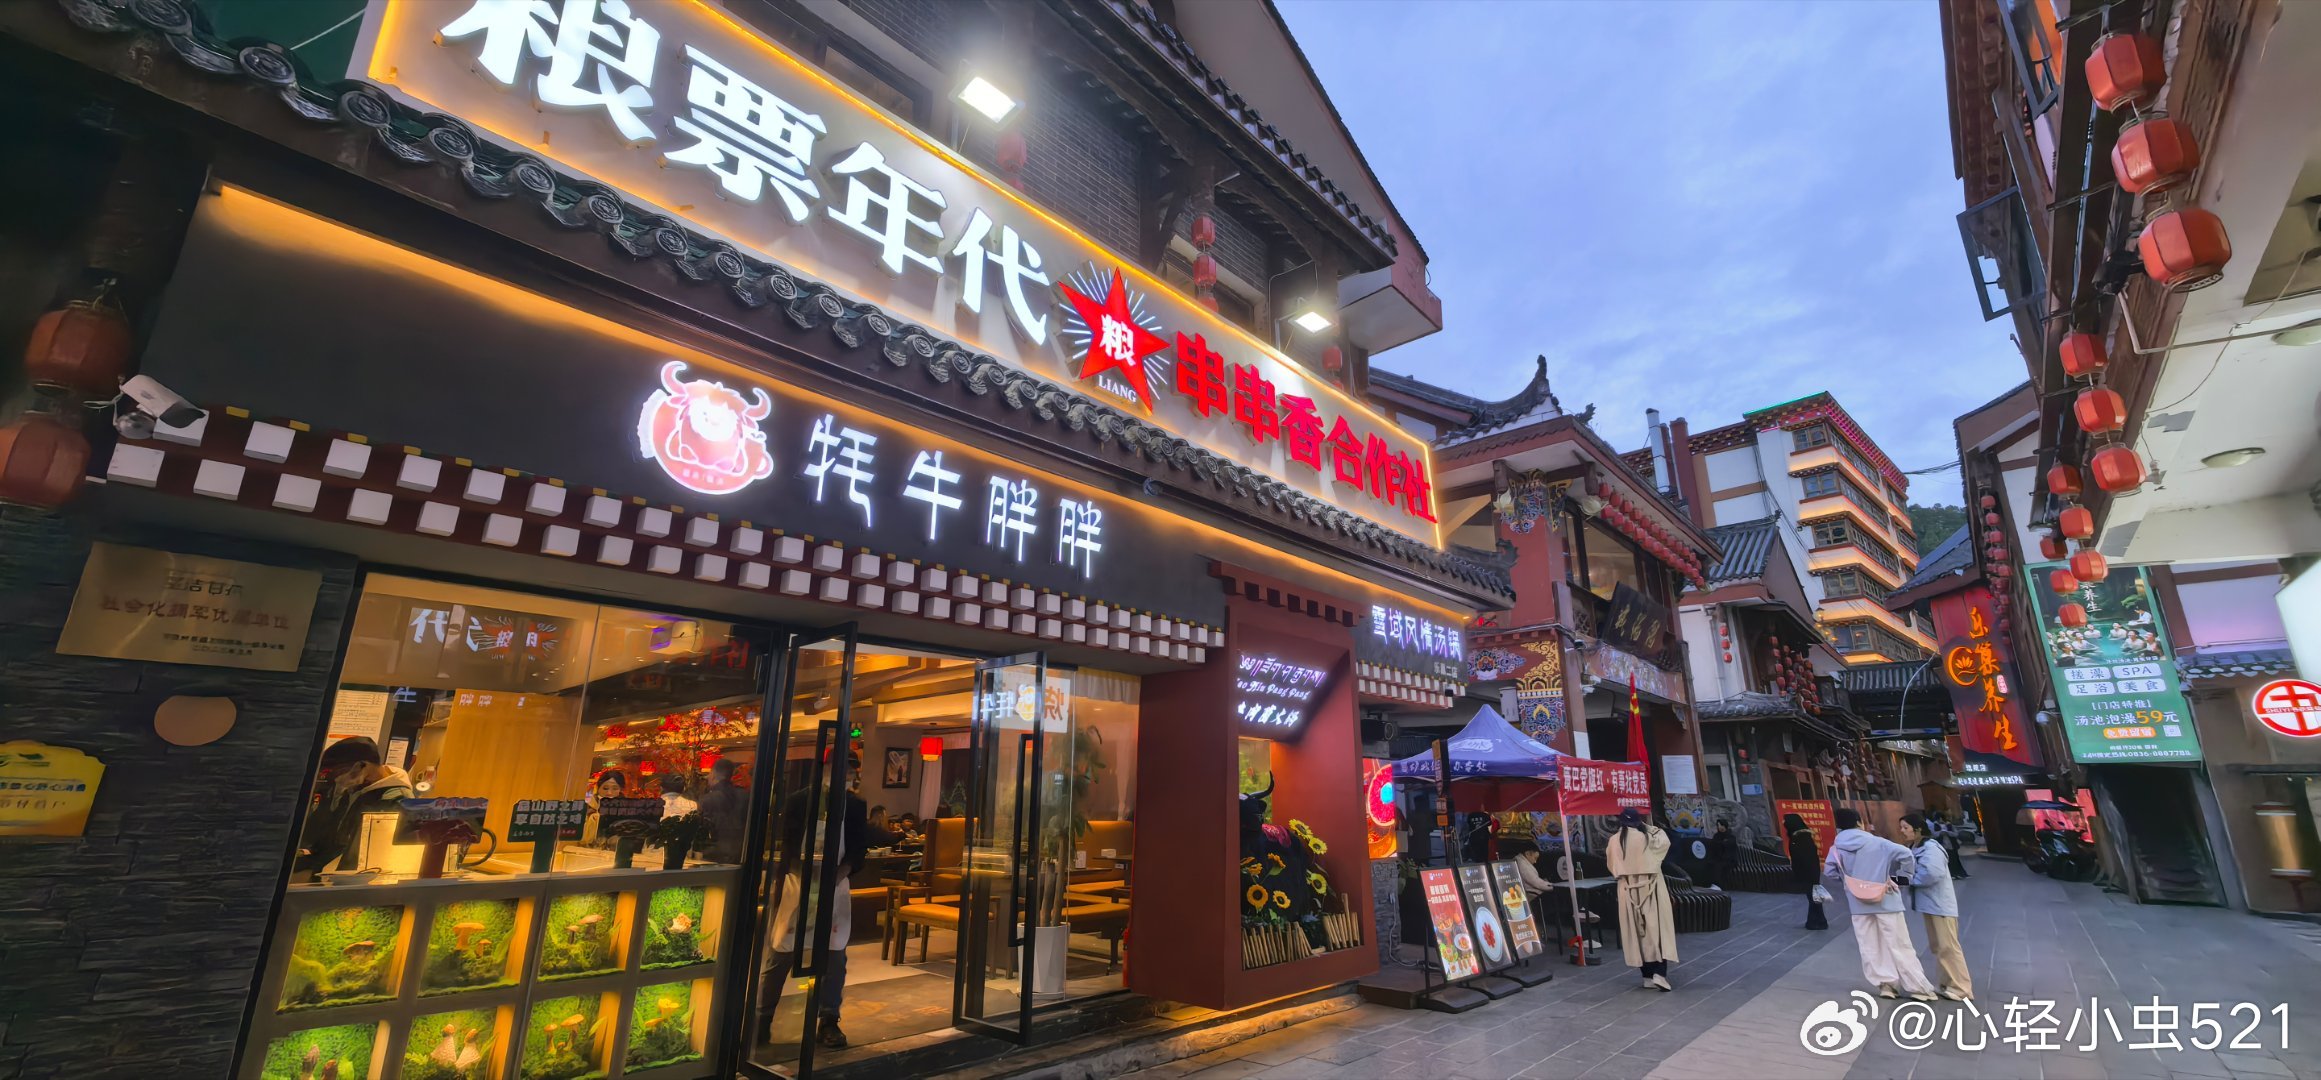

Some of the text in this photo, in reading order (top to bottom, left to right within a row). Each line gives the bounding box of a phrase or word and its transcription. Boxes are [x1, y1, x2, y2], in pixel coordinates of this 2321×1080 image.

[1098, 373, 1138, 404] LIANG
[1099, 314, 1136, 366] 粮
[1176, 330, 1438, 524] 串串香合作社
[804, 414, 1102, 578] 牦牛胖胖
[1372, 604, 1463, 662] 雪域风情汤锅
[2122, 666, 2152, 677] SPA
[2123, 680, 2158, 692] 美食
[2076, 684, 2108, 695] 足浴
